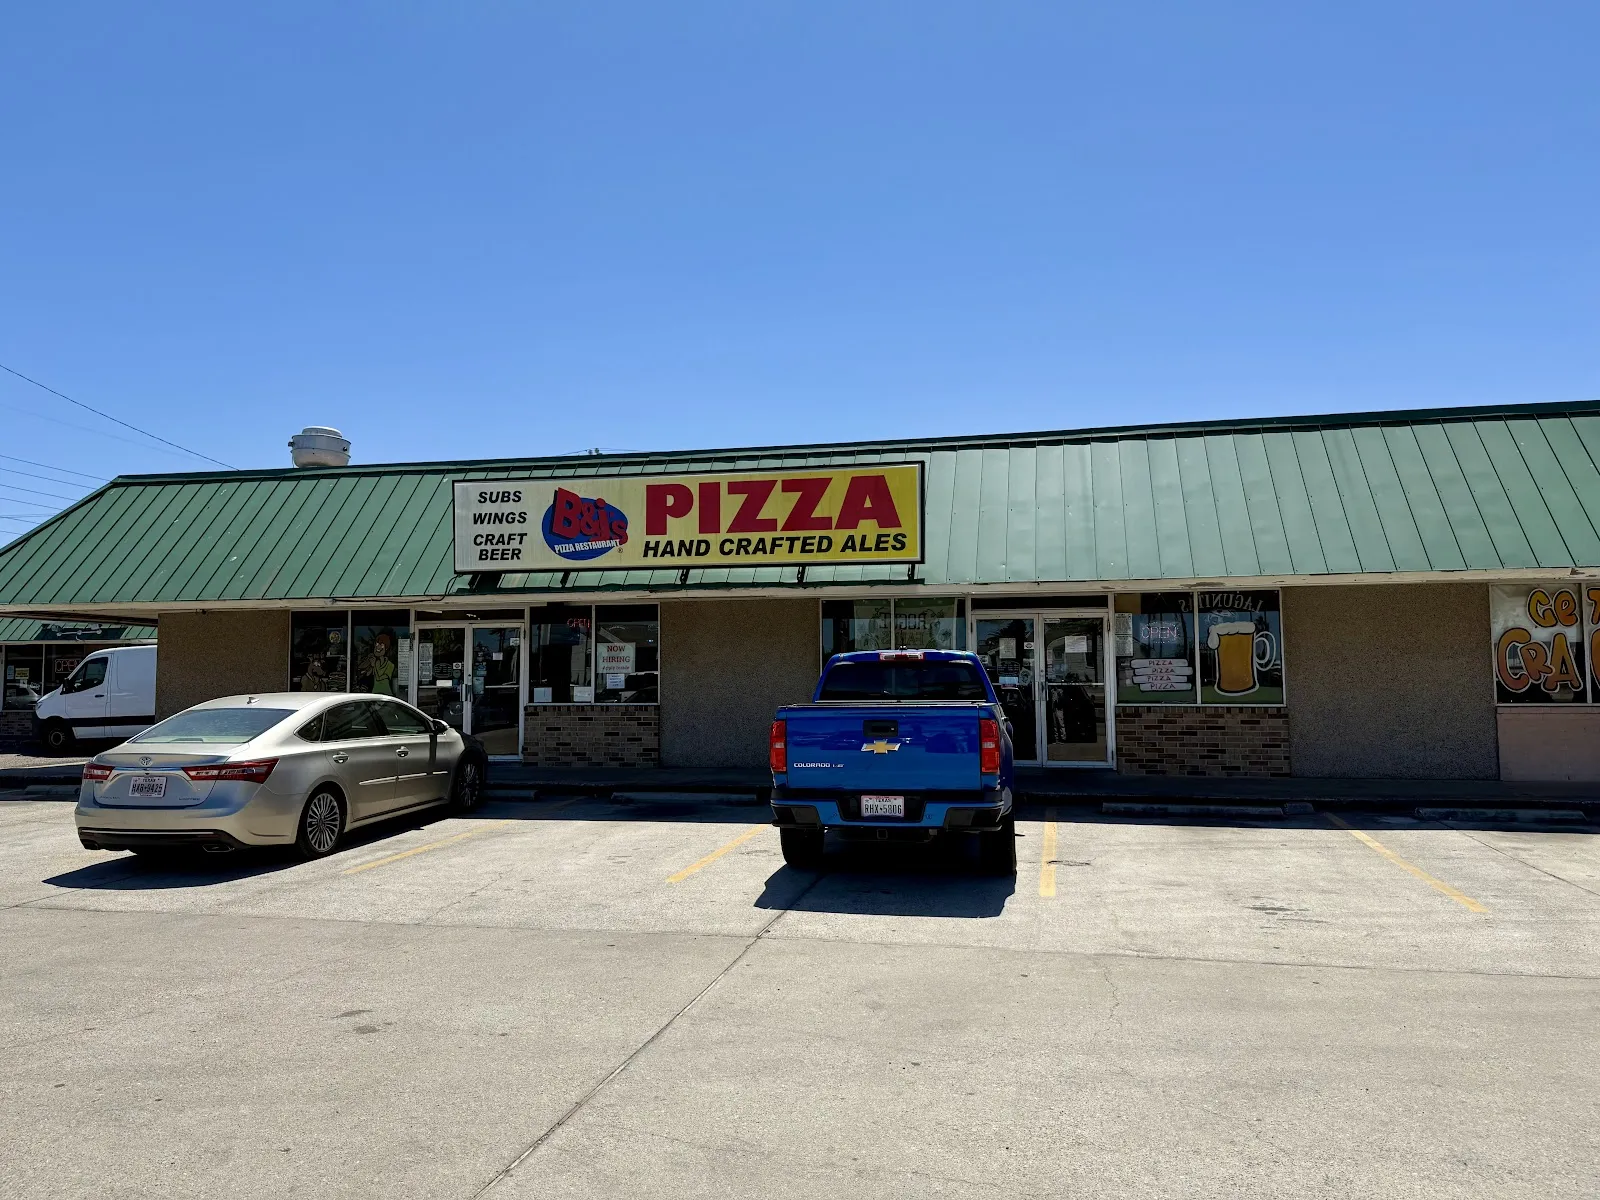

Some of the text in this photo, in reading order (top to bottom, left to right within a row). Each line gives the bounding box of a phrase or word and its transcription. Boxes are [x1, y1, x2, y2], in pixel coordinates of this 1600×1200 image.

[477, 490, 523, 504] SUBS
[645, 475, 902, 536] PIZZA
[472, 510, 528, 526] WINGS
[472, 532, 528, 547] CRAFT
[554, 538, 620, 554] PIZZA RESTAURANT
[642, 532, 907, 559] HAND CRAFTED ALES
[477, 546, 523, 561] BEER
[1140, 626, 1178, 640] OPEN
[606, 645, 626, 653] NOW
[602, 655, 631, 663] HIRING
[1496, 627, 1600, 692] CRA
